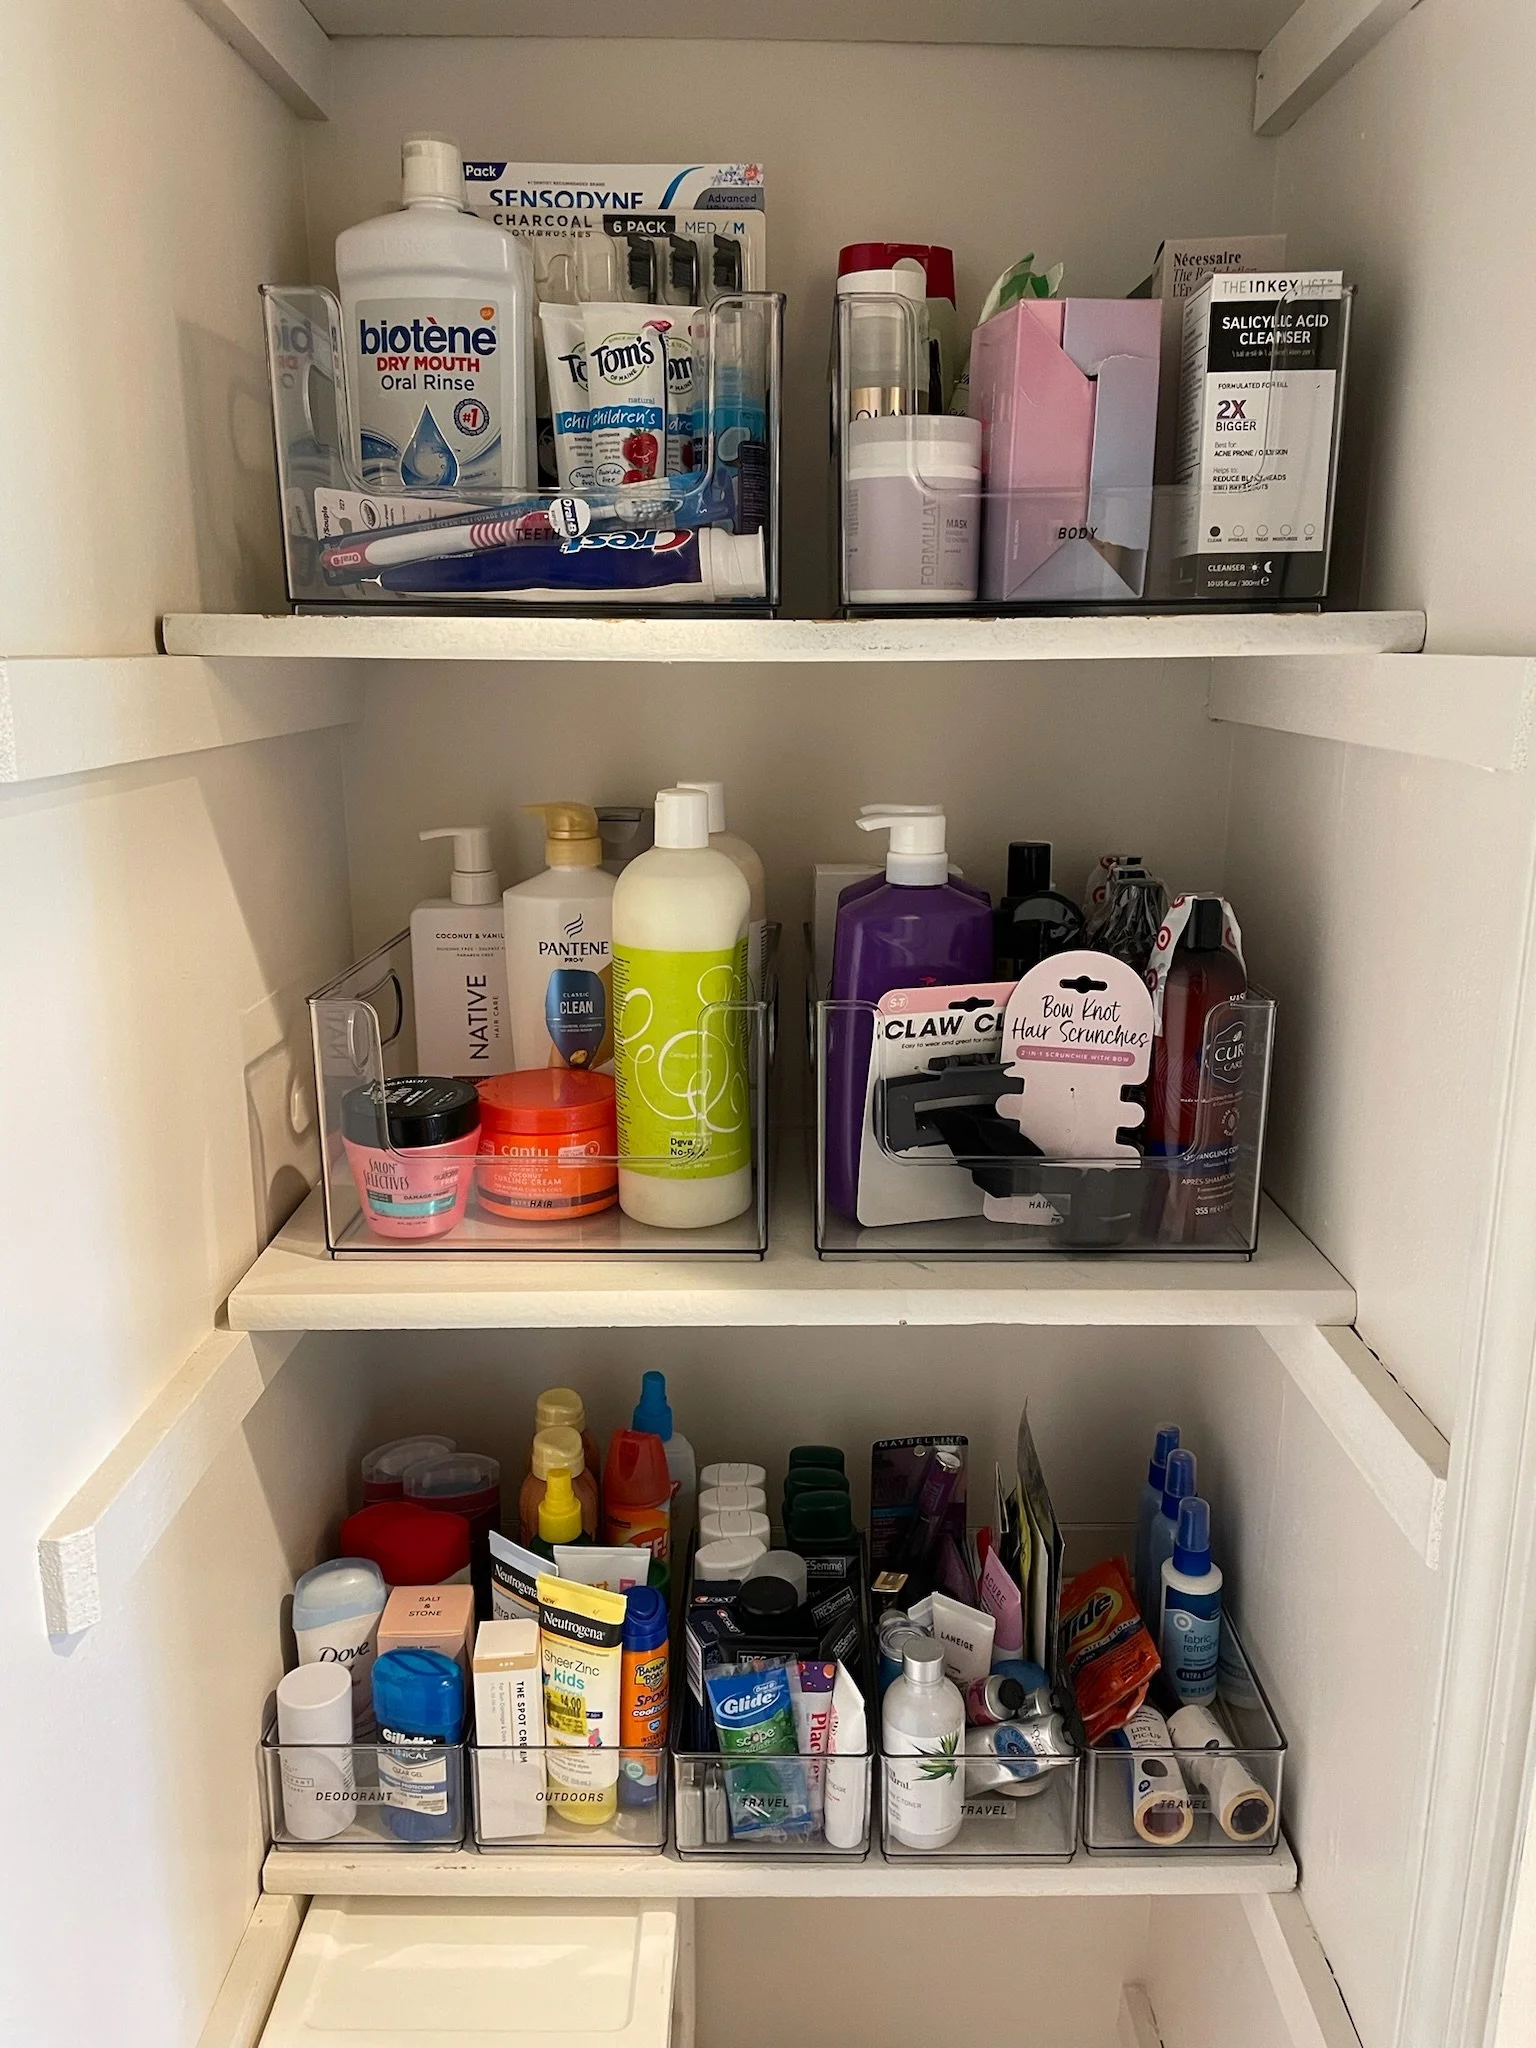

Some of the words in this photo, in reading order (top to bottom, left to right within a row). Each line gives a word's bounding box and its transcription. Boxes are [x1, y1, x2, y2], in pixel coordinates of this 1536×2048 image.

[466, 165, 496, 177] Pack
[490, 189, 643, 209] SENSODYNE
[708, 193, 757, 205] Advanced
[493, 214, 593, 228] CHARCOAL
[612, 221, 622, 234] 6
[626, 221, 667, 234] PACK
[685, 221, 717, 235] MED
[733, 222, 745, 235] M
[1174, 251, 1242, 267] Nécessaire
[1223, 281, 1246, 294] THE
[1222, 316, 1293, 329] SALICYLIC
[1296, 314, 1330, 328] ACID
[360, 317, 497, 356] biotène
[1239, 331, 1311, 345] CLEANSER
[591, 337, 655, 377] Tom's
[376, 356, 410, 372] DRY
[414, 356, 480, 373] MOUTH
[618, 368, 637, 381] MAINE
[381, 374, 416, 391] Oral
[424, 374, 475, 392] Rinse
[1216, 399, 1247, 420] 2X
[462, 408, 479, 428] #1
[592, 408, 656, 426] children's
[1215, 421, 1257, 432] BIGGER
[563, 498, 580, 535] Oral-B
[946, 519, 968, 529] MASK
[515, 528, 561, 542] TEETH
[1057, 527, 1098, 540] BODY
[563, 529, 692, 555] Crest
[333, 553, 360, 565] Oral-B
[1207, 563, 1246, 573] CLEANSER
[538, 941, 610, 956] PANTENE
[559, 1001, 594, 1015] CLEAN
[1042, 995, 1074, 1019] Bow
[1082, 998, 1121, 1023] Knot
[466, 974, 489, 1060] NATIVE
[885, 1016, 964, 1041] CLAW
[1012, 1017, 1052, 1041] Hair
[1059, 1020, 1150, 1048] Scrunchies
[955, 1038, 973, 1047] great
[1045, 1051, 1088, 1060] SCRUNCHIE
[369, 1159, 395, 1175] SALON
[363, 1170, 410, 1190] SELECTIVES
[529, 1200, 553, 1208] HAIR
[1029, 1201, 1053, 1210] HAIR
[1194, 1206, 1209, 1216] 355
[879, 1435, 964, 1448] MAYBELLINE
[984, 1573, 1007, 1604] ACURE
[543, 1610, 604, 1641] Neutrogena
[1064, 1595, 1113, 1644] Tide
[940, 1631, 974, 1652] LANEIGE
[1184, 1633, 1211, 1644] fabric
[319, 1640, 370, 1664] Dove
[554, 1668, 585, 1690] kids
[516, 1680, 525, 1699] THE
[723, 1692, 776, 1714] Glide
[517, 1702, 527, 1726] SPOT
[1130, 1726, 1152, 1734] LINT
[1132, 1731, 1162, 1741] PIC-UP
[382, 1728, 434, 1751] Gillette
[736, 1728, 776, 1747] scope
[392, 1766, 409, 1776] CLEAR
[315, 1791, 393, 1802] DEODORANT
[535, 1792, 604, 1802] OUTDOORS
[741, 1797, 790, 1808] TRAVEL
[960, 1805, 1008, 1815] TRAVEL
[1160, 1799, 1208, 1809] TRAVEL
